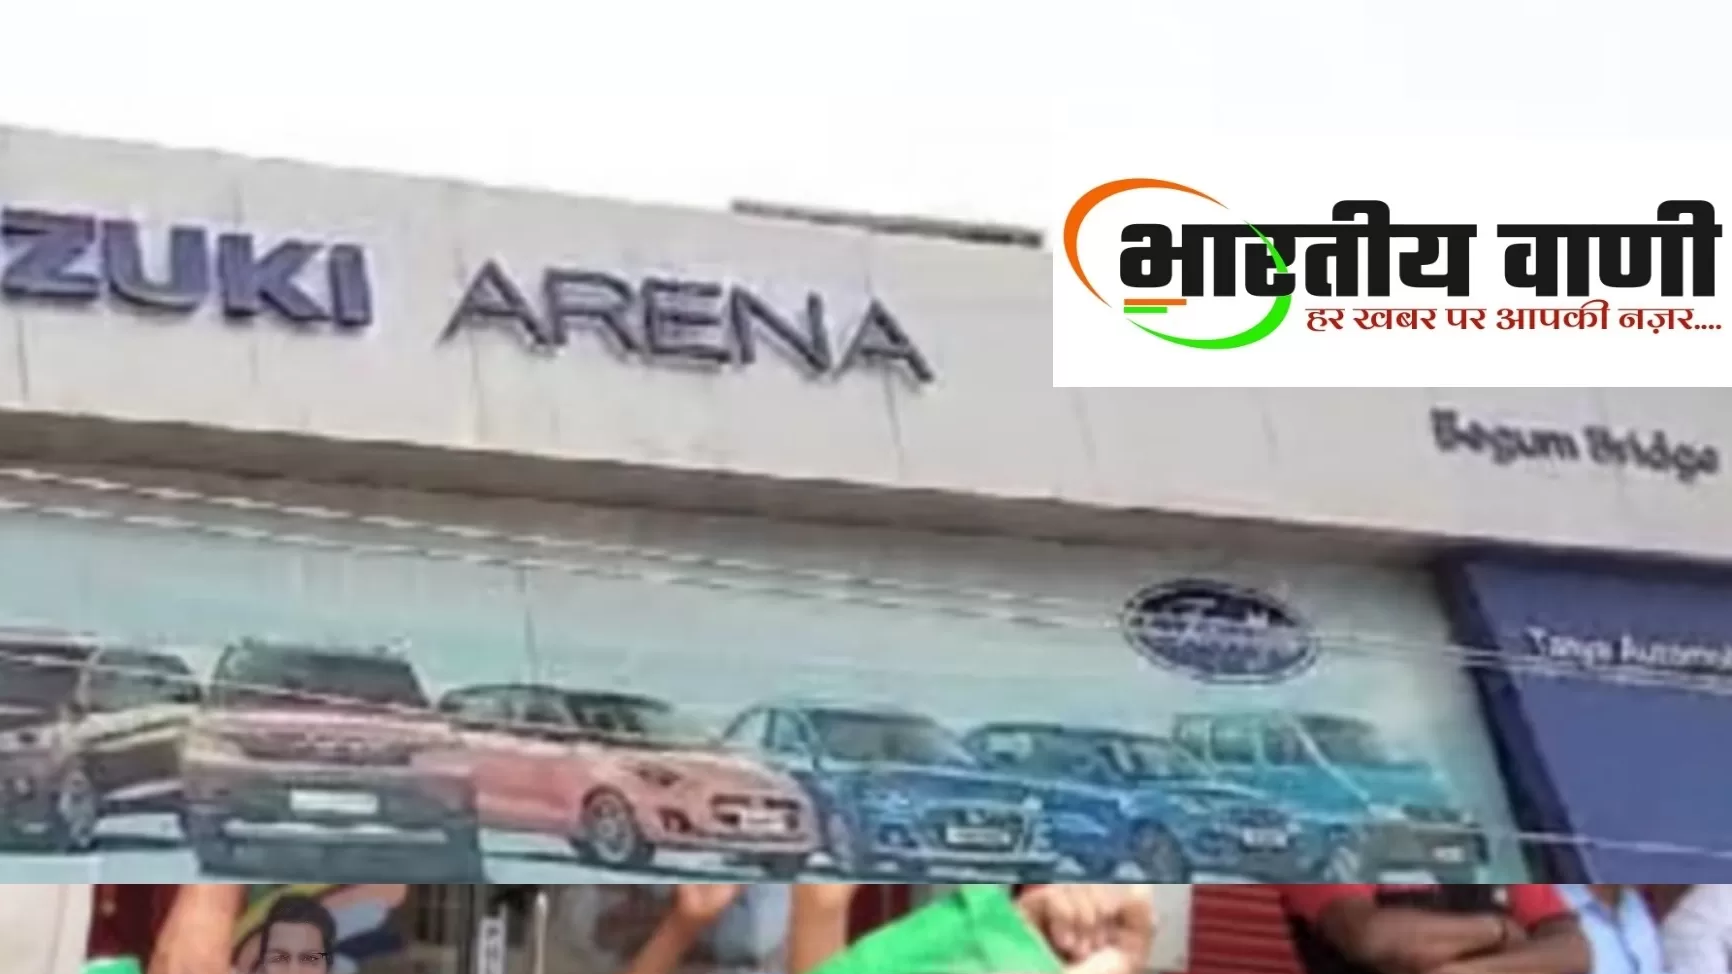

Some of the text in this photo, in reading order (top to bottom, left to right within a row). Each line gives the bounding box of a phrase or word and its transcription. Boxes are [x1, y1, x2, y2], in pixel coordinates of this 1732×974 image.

[437, 257, 935, 384] ARENA
[1429, 406, 1720, 486] Begum Bridge
